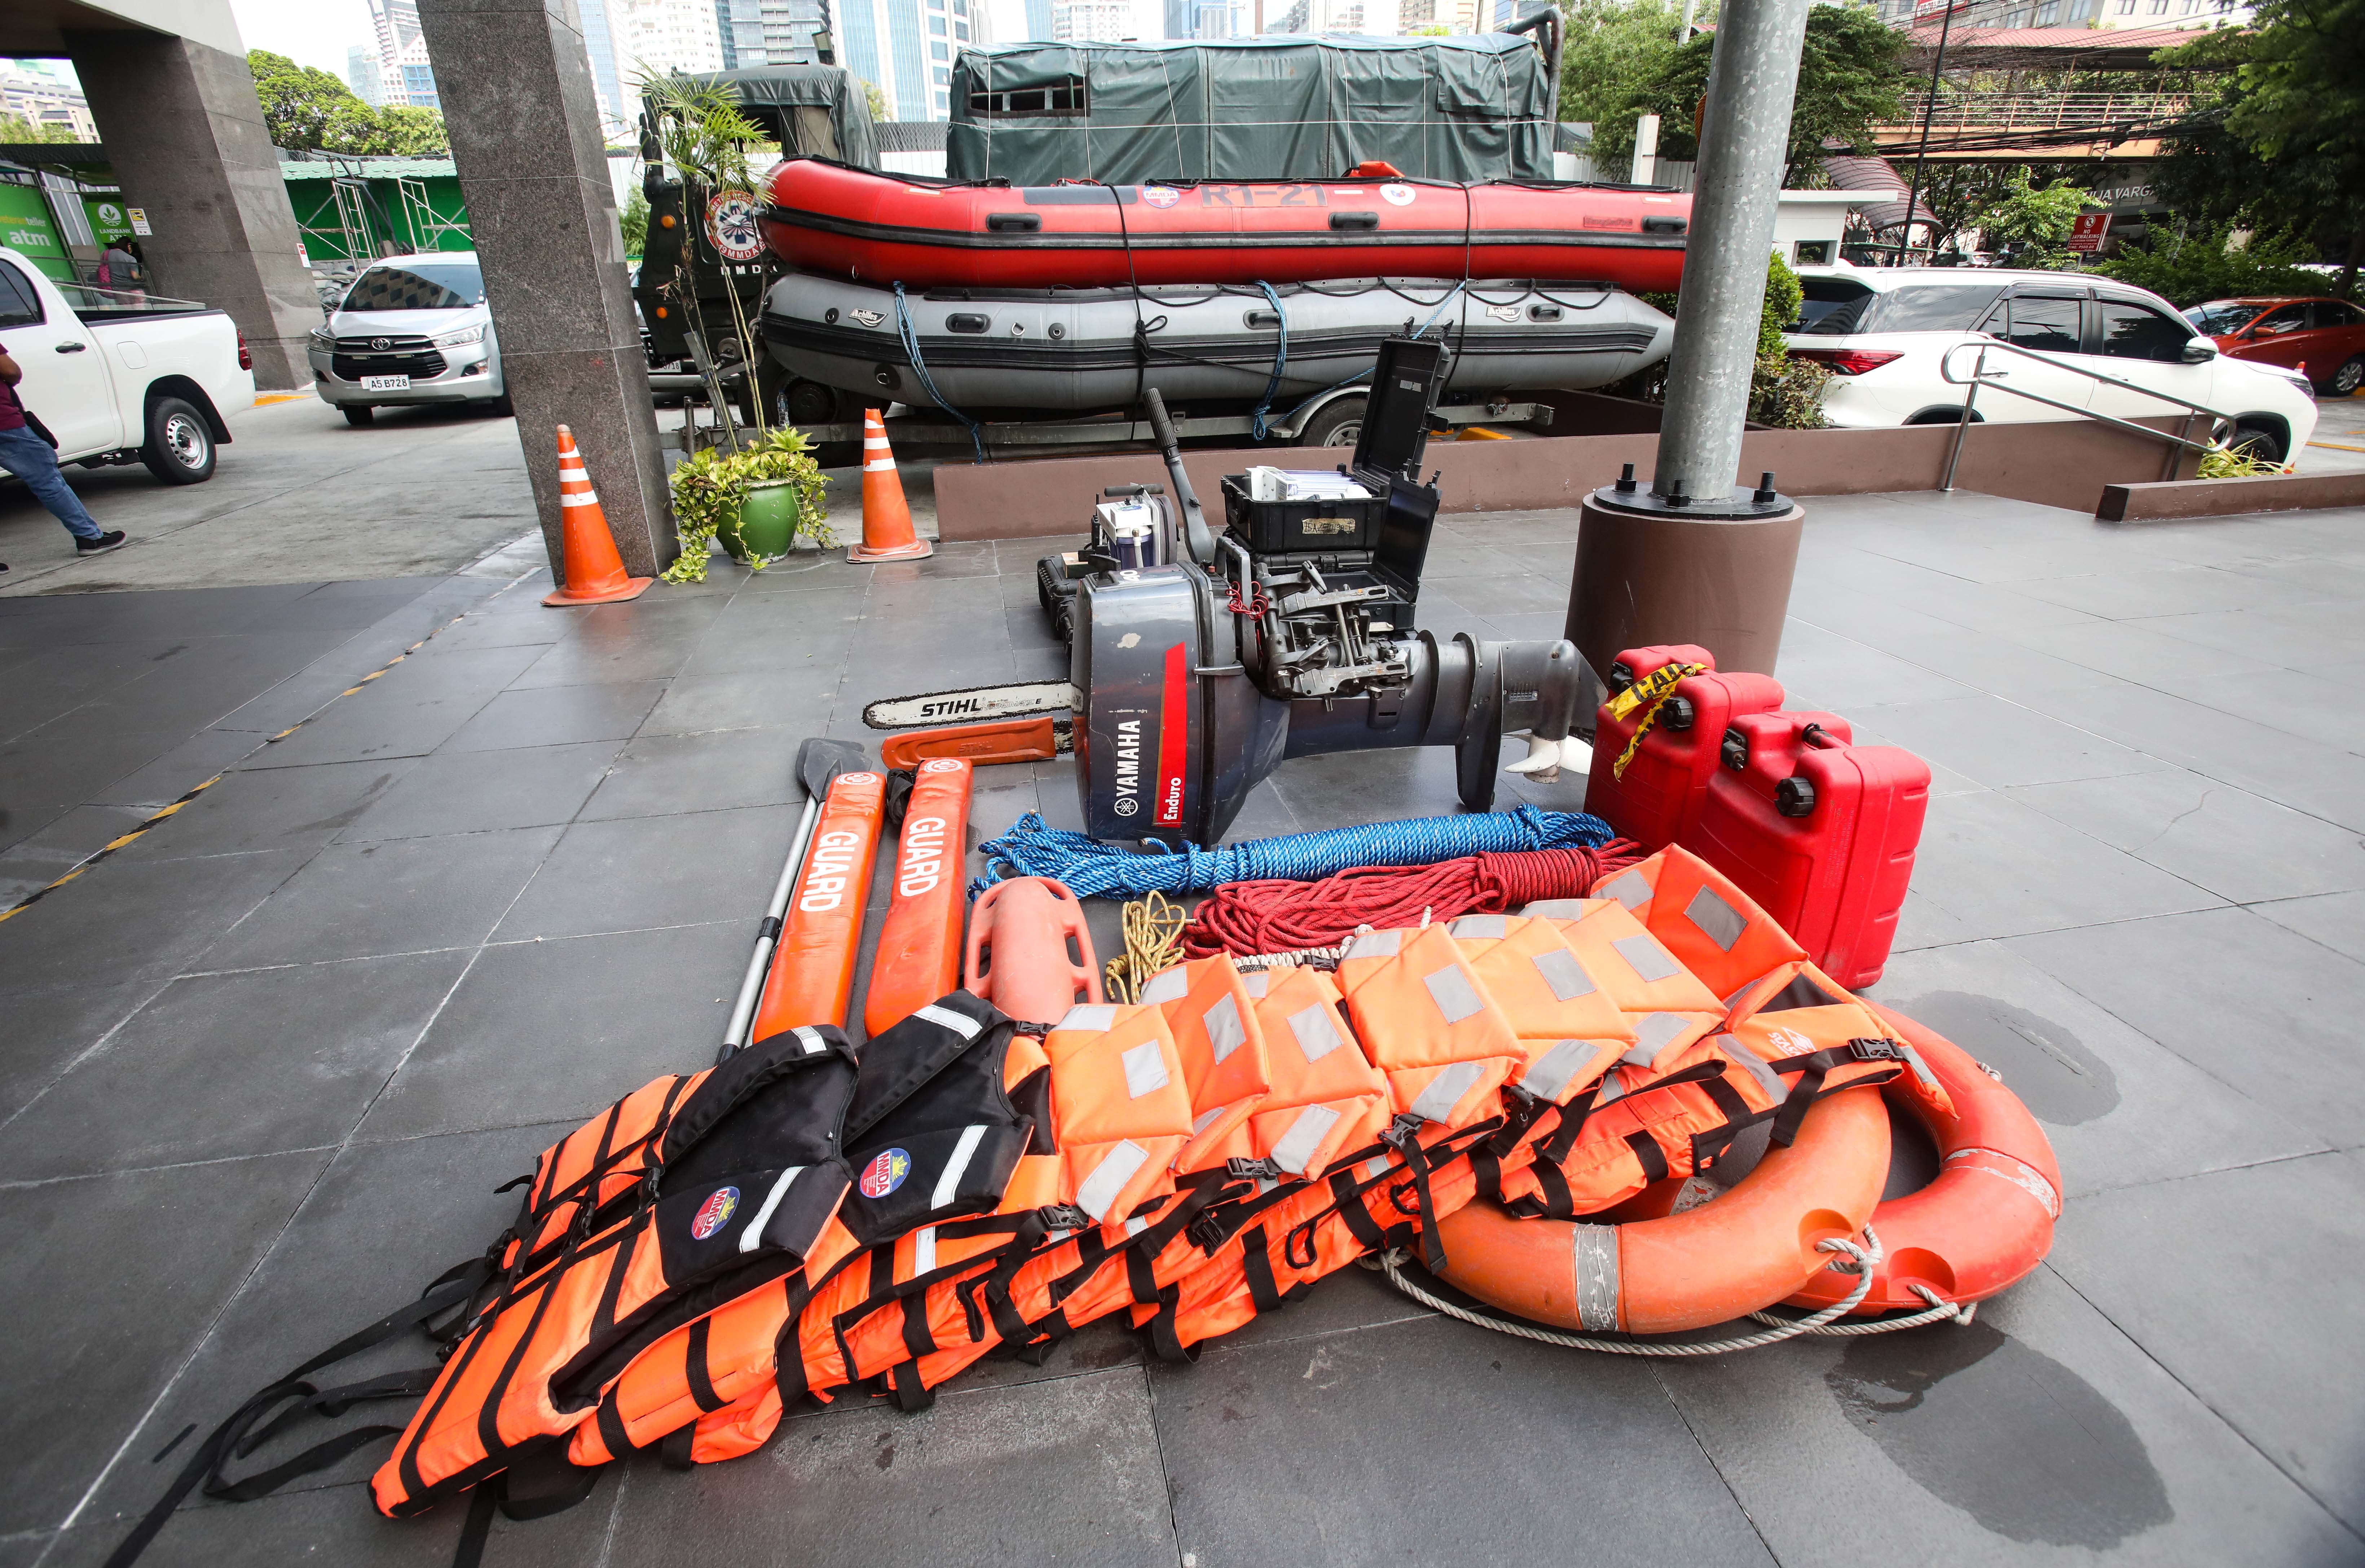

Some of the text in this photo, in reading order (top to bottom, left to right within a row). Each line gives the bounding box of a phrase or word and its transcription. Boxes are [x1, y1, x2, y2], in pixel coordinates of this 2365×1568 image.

[1199, 185, 1327, 206] R1-21
[9, 229, 50, 246] atm
[850, 309, 878, 321] Achilles
[384, 379, 407, 388] B728
[1119, 570, 1140, 581] 40
[920, 698, 982, 717] STIHL
[1117, 720, 1140, 797] YAMAHA
[1163, 777, 1181, 820] Enduro
[800, 831, 859, 912] GUARD
[900, 817, 946, 897] GUARD
[877, 1153, 890, 1195] MMDA
[700, 1190, 728, 1237] MMDA
